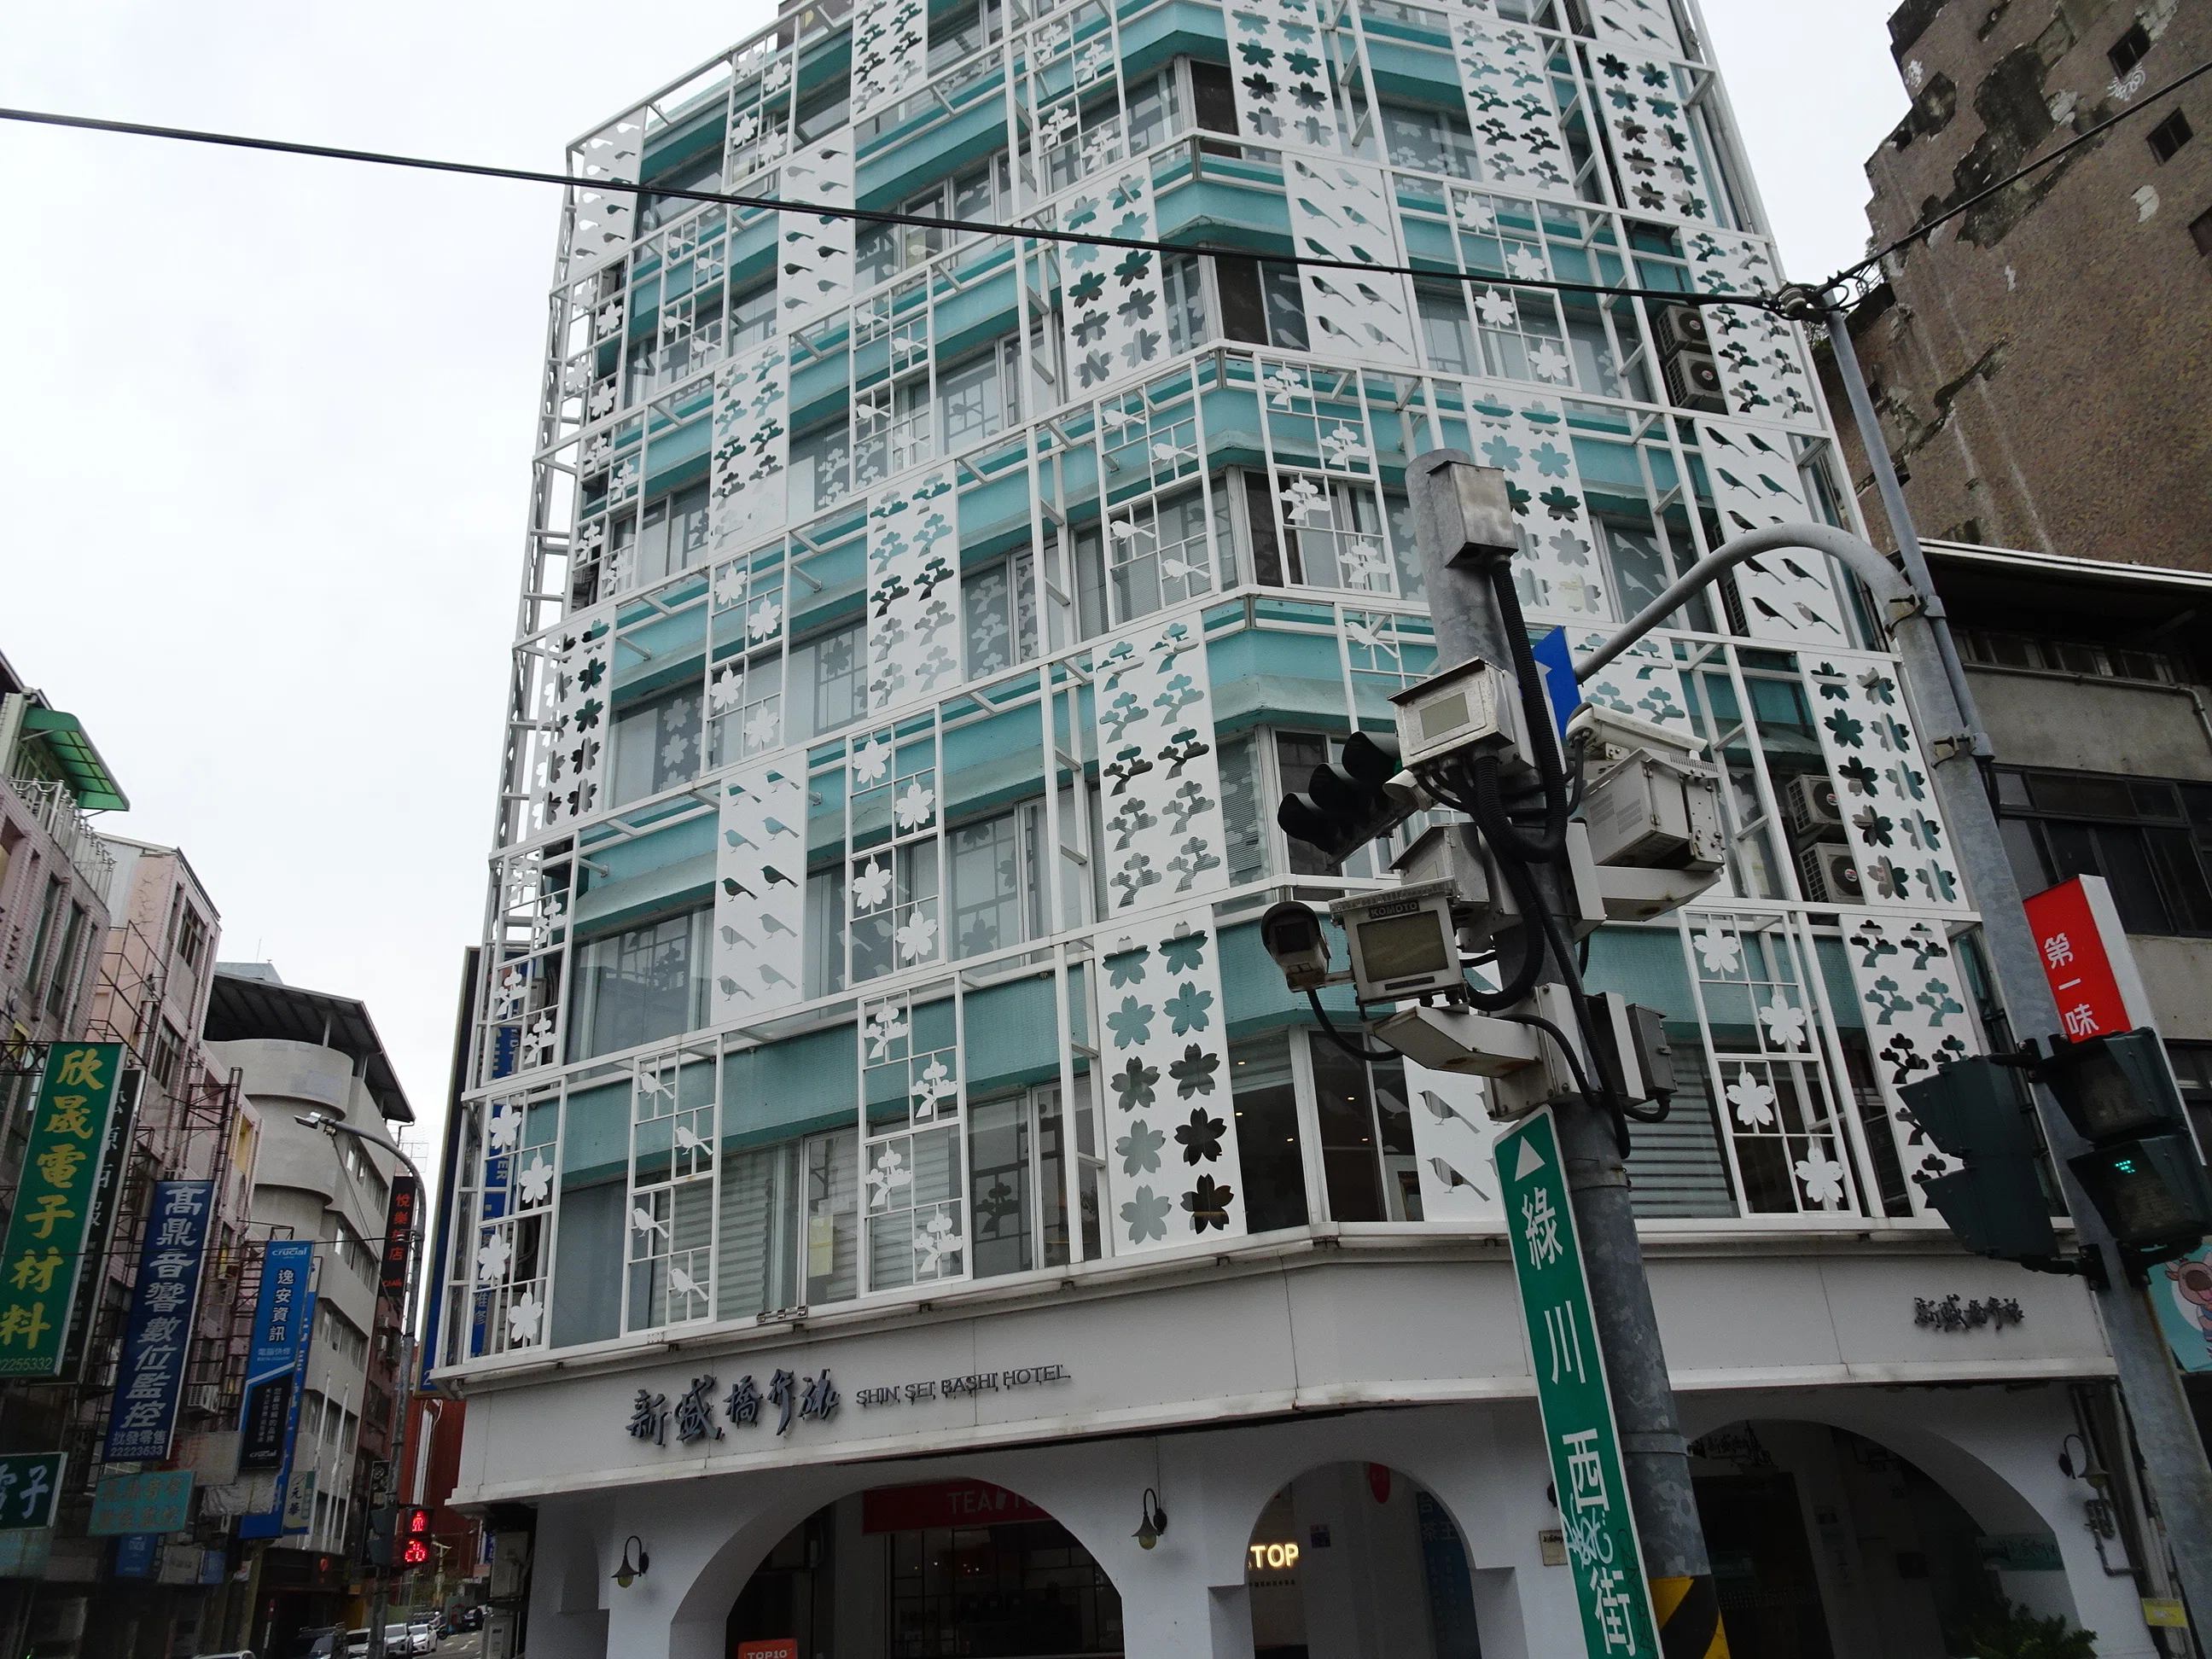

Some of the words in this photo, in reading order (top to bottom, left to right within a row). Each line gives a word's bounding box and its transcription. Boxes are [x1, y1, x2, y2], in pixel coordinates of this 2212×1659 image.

[1371, 902, 1417, 917] KOMOTO
[2045, 933, 2099, 1036] 第一味
[0, 1047, 105, 1350] 欣晟電子材料
[271, 1247, 307, 1257] crucial
[269, 1268, 295, 1342] 逸安資訊
[0, 1357, 54, 1372] 2255332
[856, 1385, 900, 1406] SHIN
[905, 1381, 936, 1403] SEI
[941, 1372, 998, 1395] BASHI
[1003, 1364, 1069, 1388] HOTEL
[625, 1367, 841, 1448] 新盛橋行旅
[1522, 1187, 1636, 1657] 綠川西街
[112, 1429, 166, 1447] 批發零售
[110, 1446, 163, 1458] 22223633
[947, 1489, 993, 1515] TEA
[1249, 1544, 1299, 1569] TOP
[747, 1650, 788, 1659] TOP10
